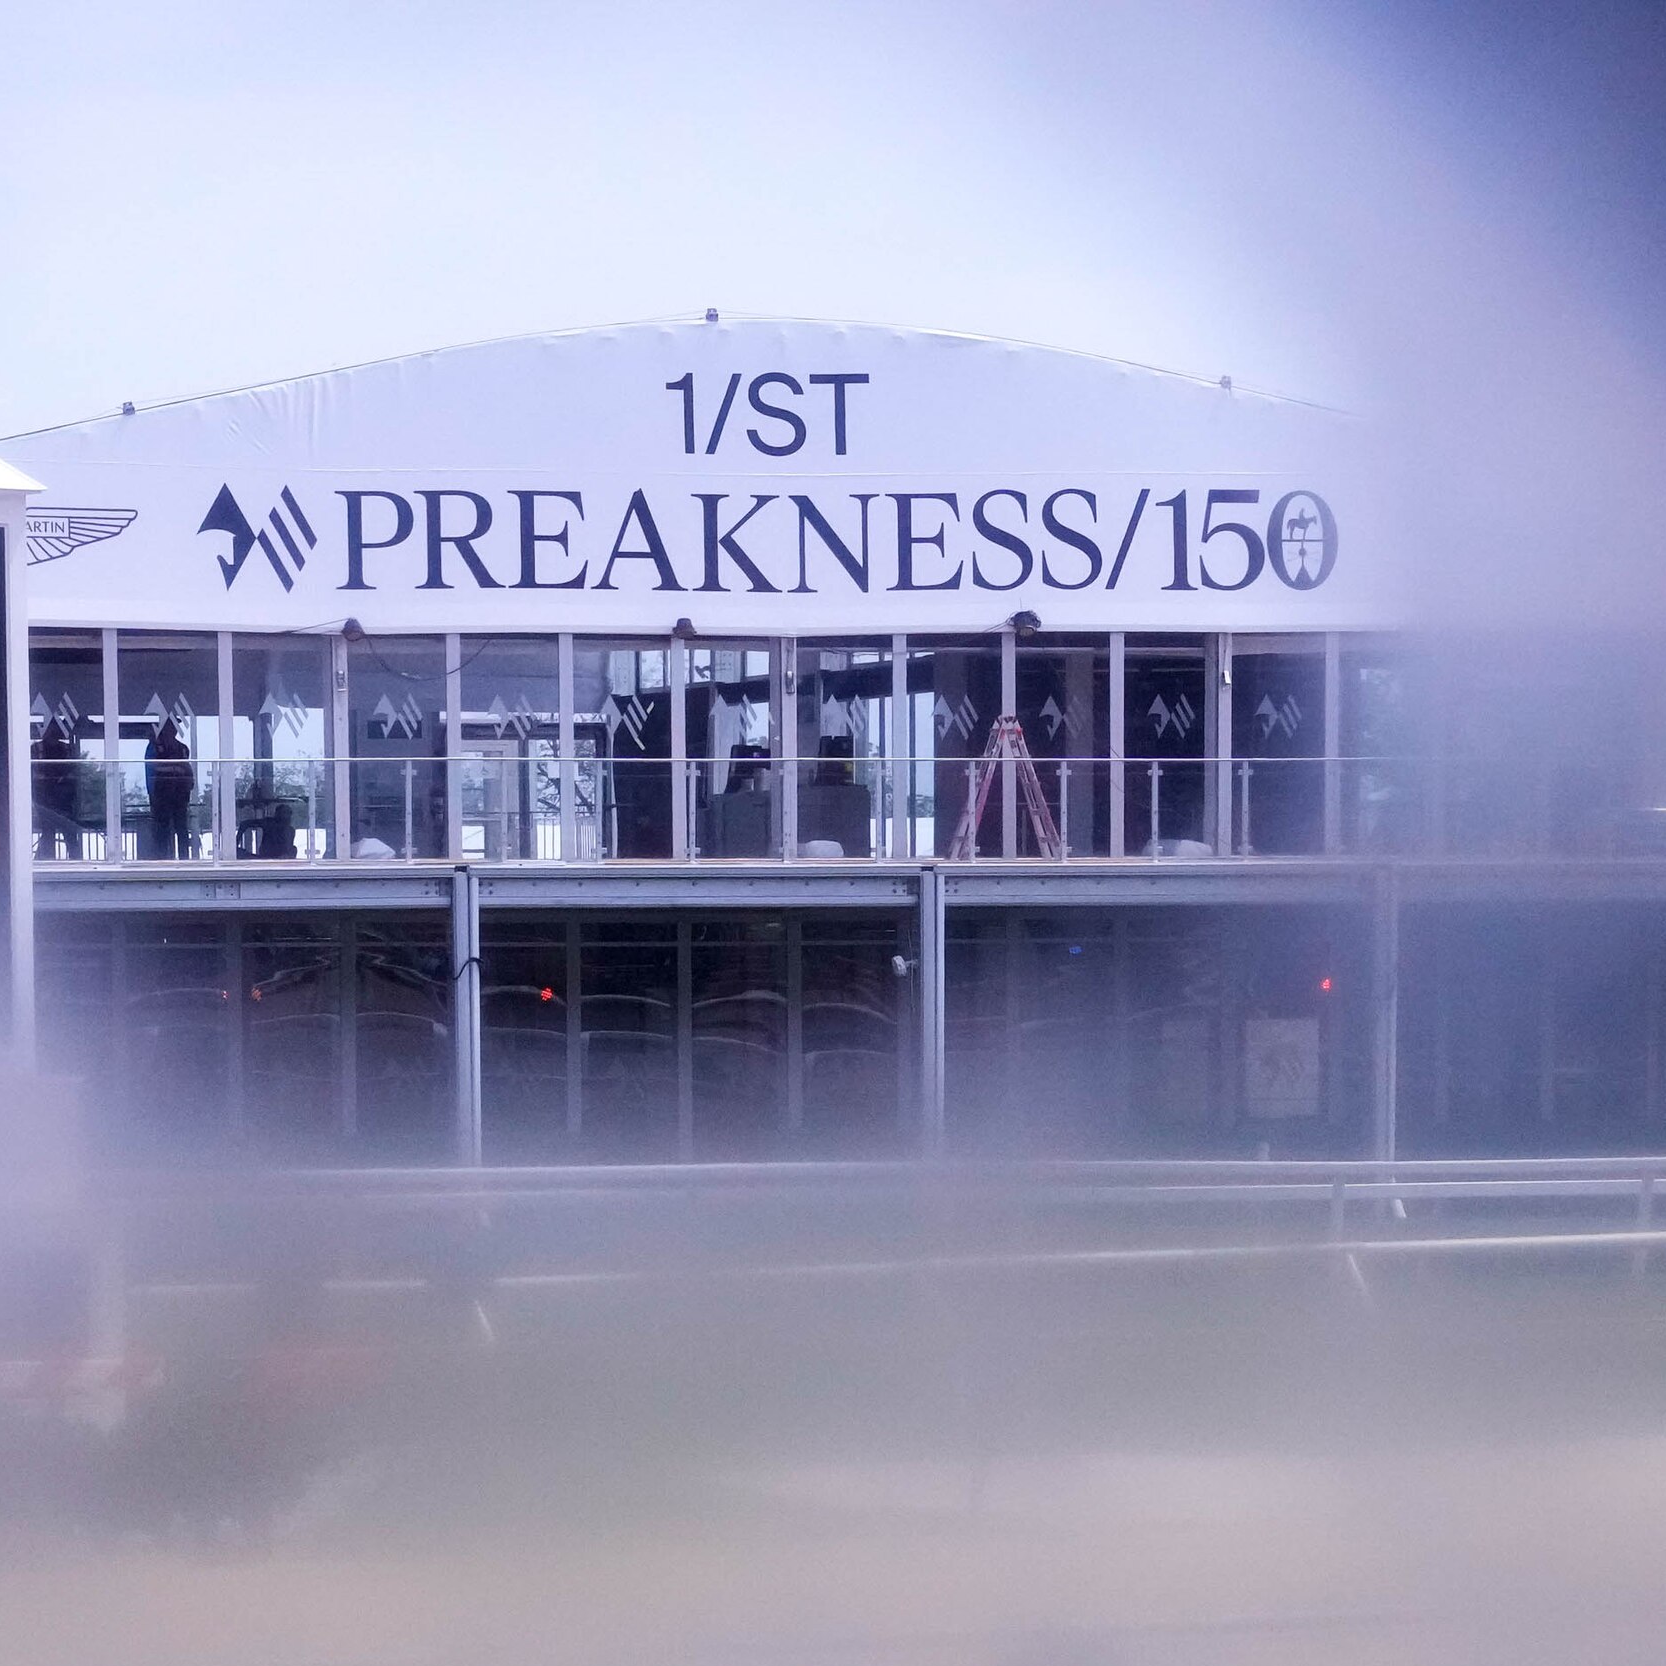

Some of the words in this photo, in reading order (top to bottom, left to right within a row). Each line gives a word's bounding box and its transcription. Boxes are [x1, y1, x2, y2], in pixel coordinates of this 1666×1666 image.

[665, 372, 870, 457] 1/ST
[26, 520, 66, 534] ARTIN
[335, 487, 1339, 592] PREAKNESS/150
